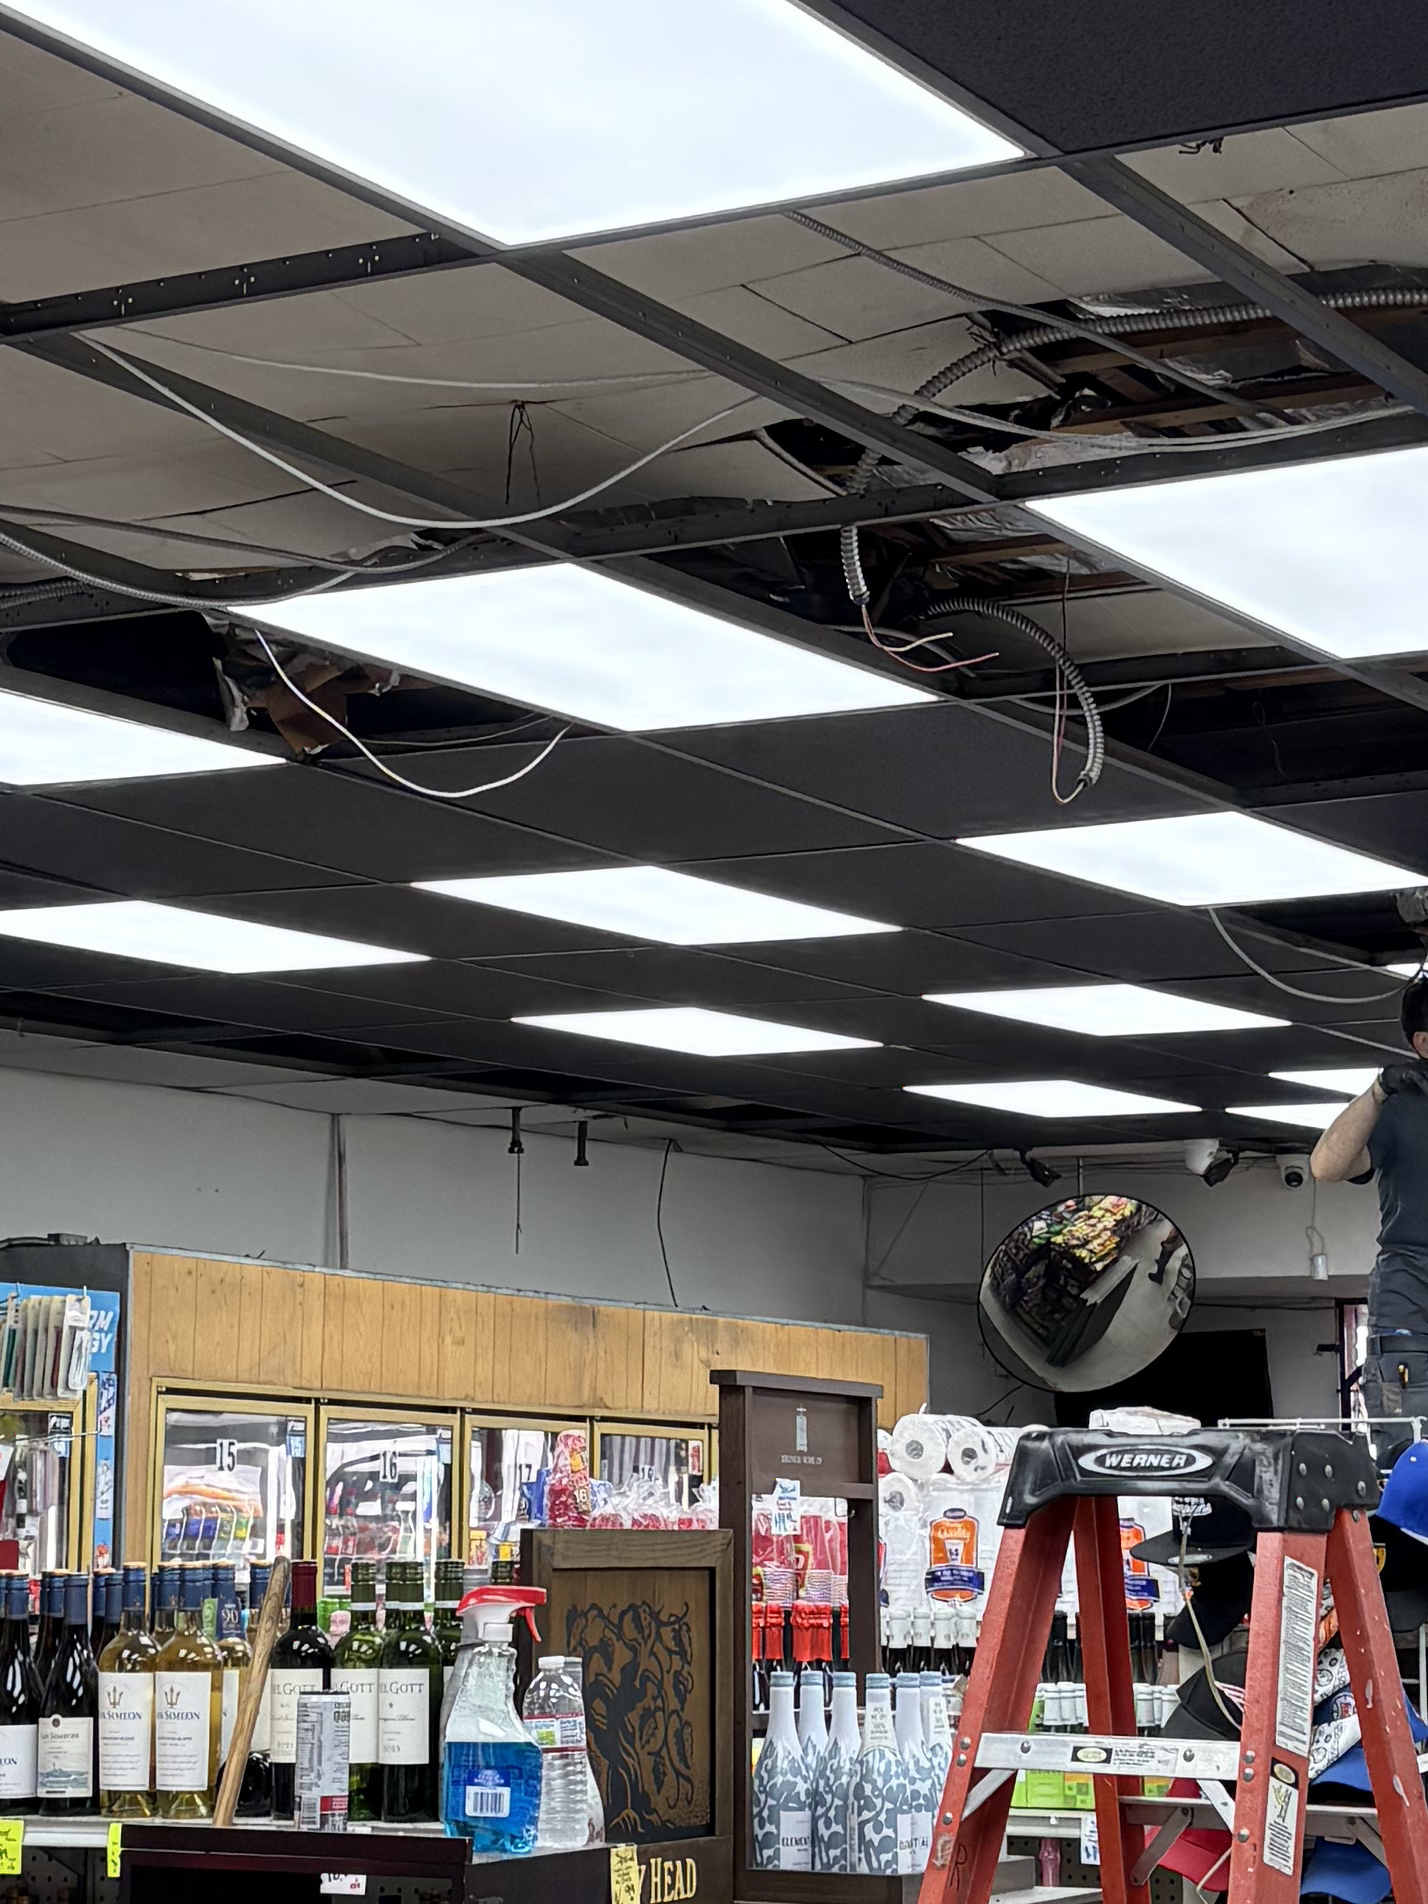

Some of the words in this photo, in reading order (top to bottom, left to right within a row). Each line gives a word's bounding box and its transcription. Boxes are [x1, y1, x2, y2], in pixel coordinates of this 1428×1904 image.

[216, 1439, 237, 1472] 15
[380, 1450, 398, 1482] 16
[1104, 1453, 1186, 1468] WERNER
[340, 1682, 373, 1694] GOTT
[390, 1683, 423, 1695] GOTT
[649, 1857, 697, 1904] HEAD
